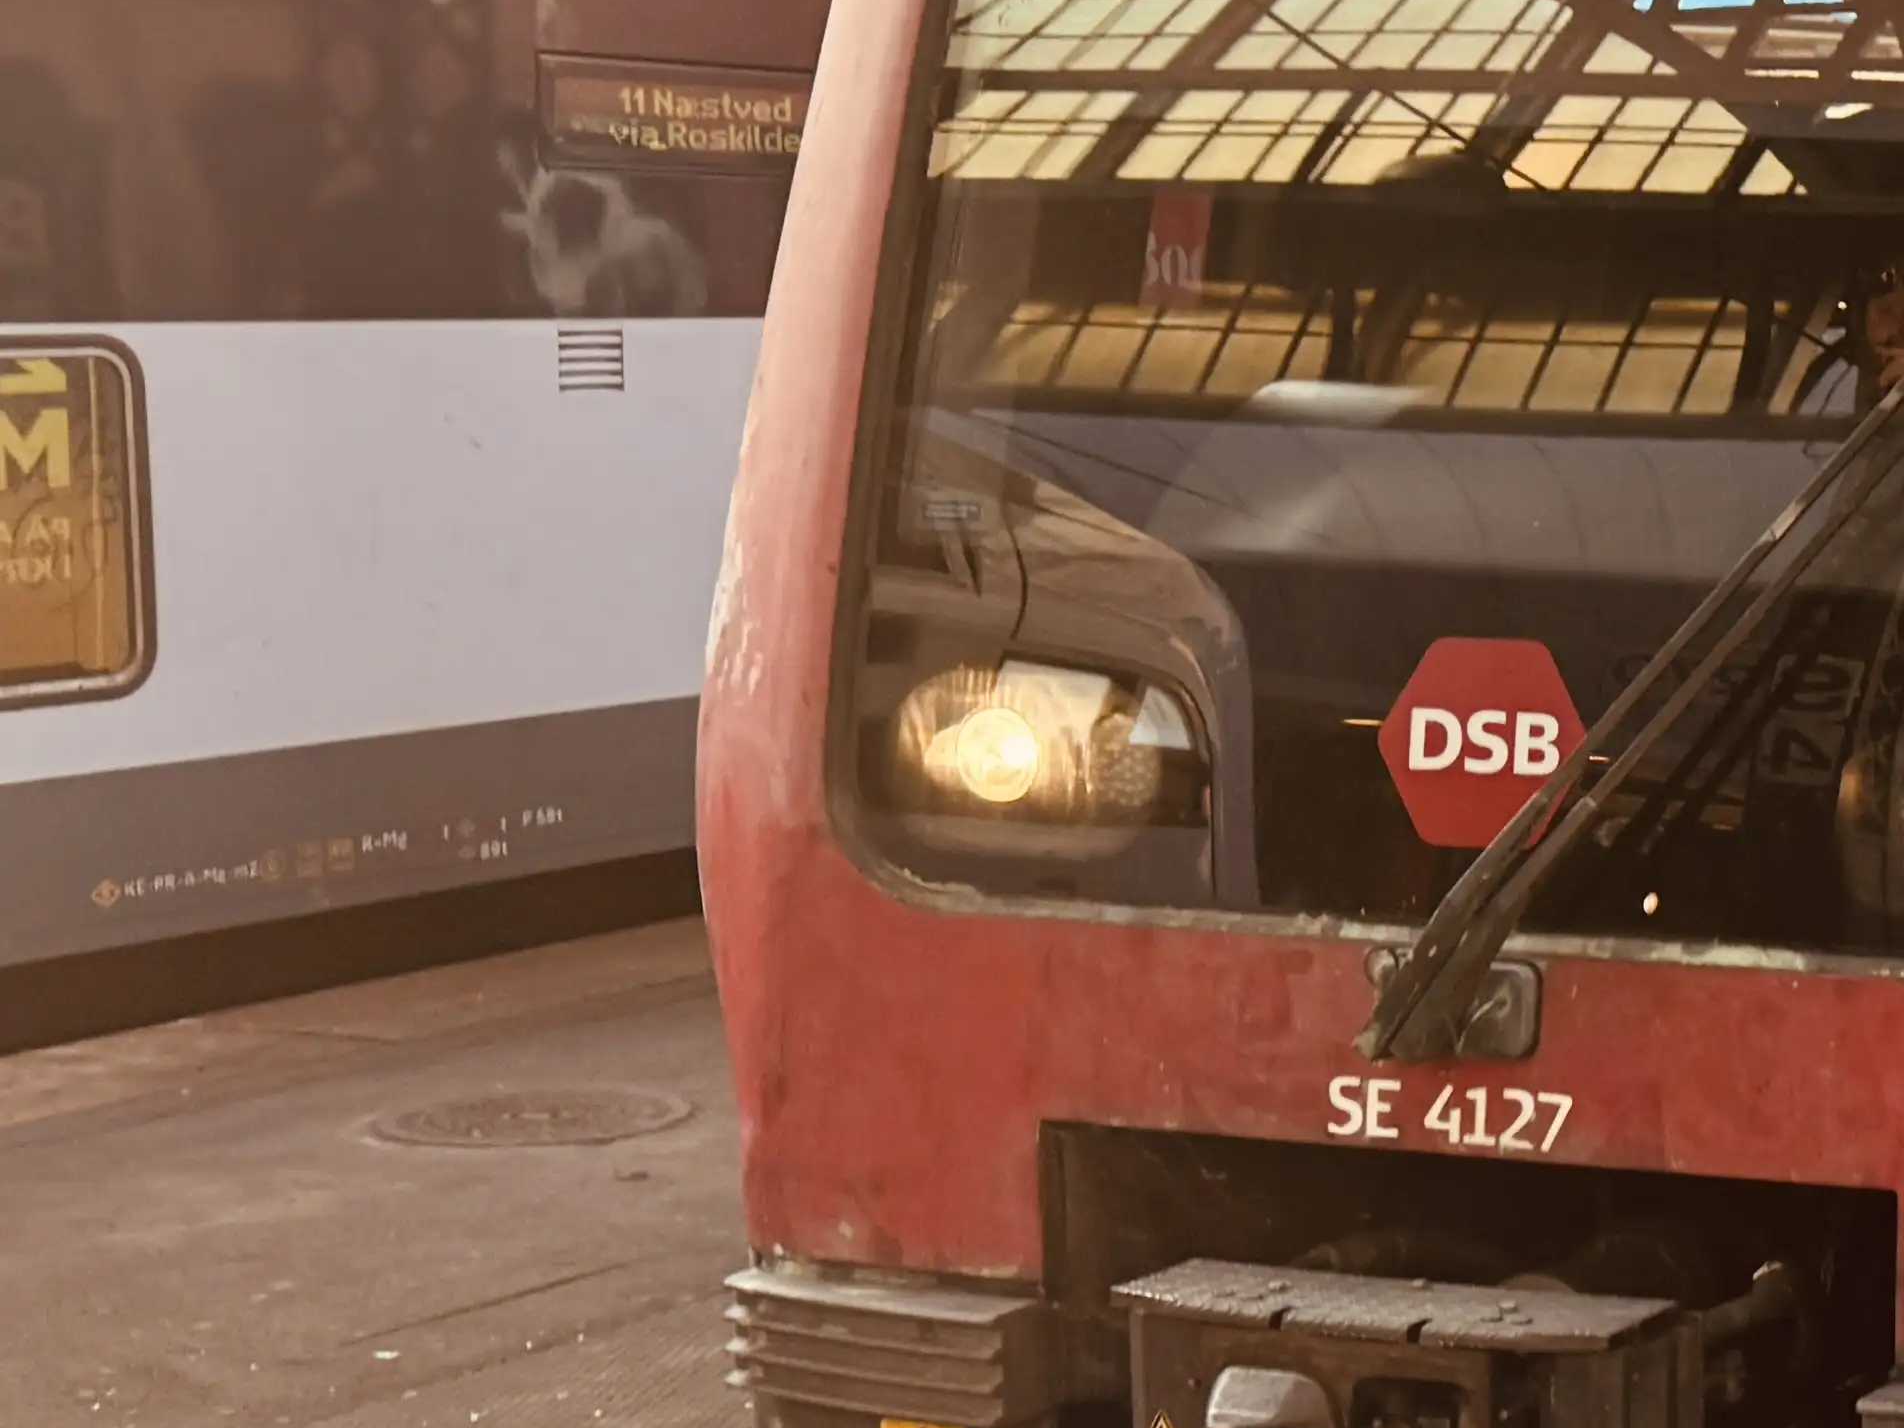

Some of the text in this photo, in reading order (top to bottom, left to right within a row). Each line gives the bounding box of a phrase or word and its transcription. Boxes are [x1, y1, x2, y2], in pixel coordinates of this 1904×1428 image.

[619, 86, 646, 116] 11
[667, 121, 801, 154] Roskilde
[1407, 706, 1561, 776] DSB
[1326, 1074, 1573, 1153] SE 4127
